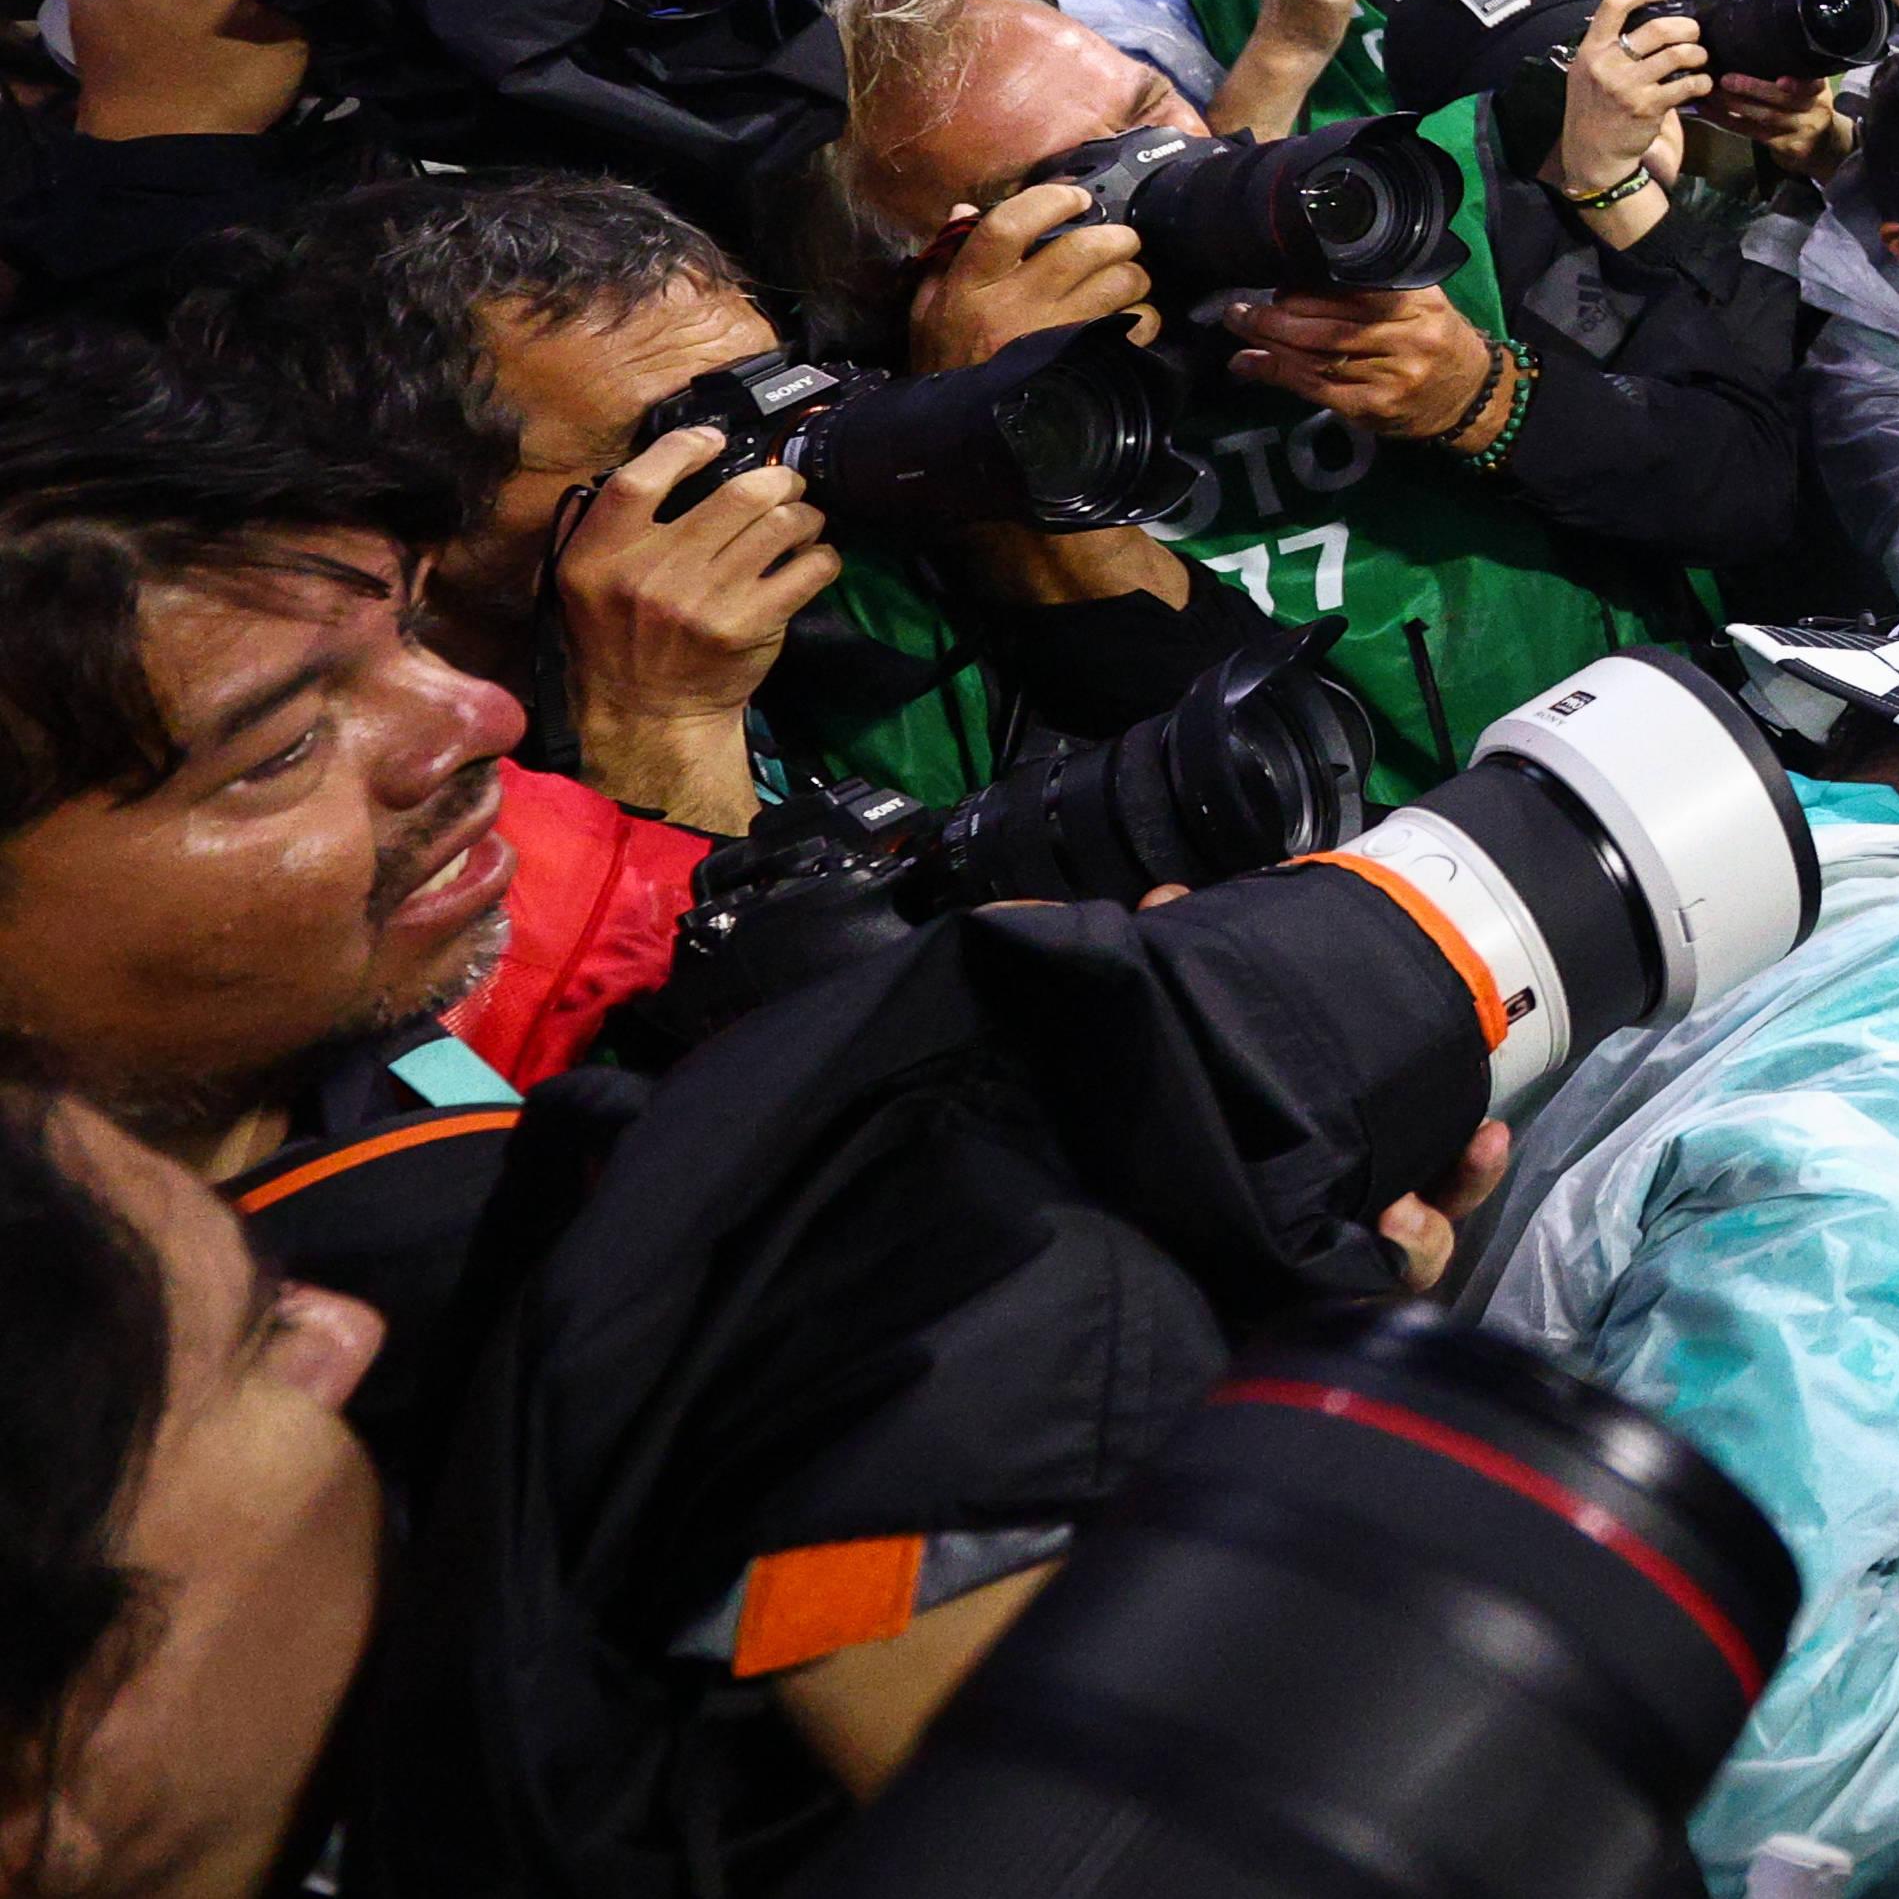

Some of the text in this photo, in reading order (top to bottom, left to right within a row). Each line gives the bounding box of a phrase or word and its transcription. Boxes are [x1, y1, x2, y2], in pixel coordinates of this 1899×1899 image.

[1137, 139, 1186, 164] Canon
[764, 376, 814, 402] SONY
[862, 797, 905, 821] SONY
